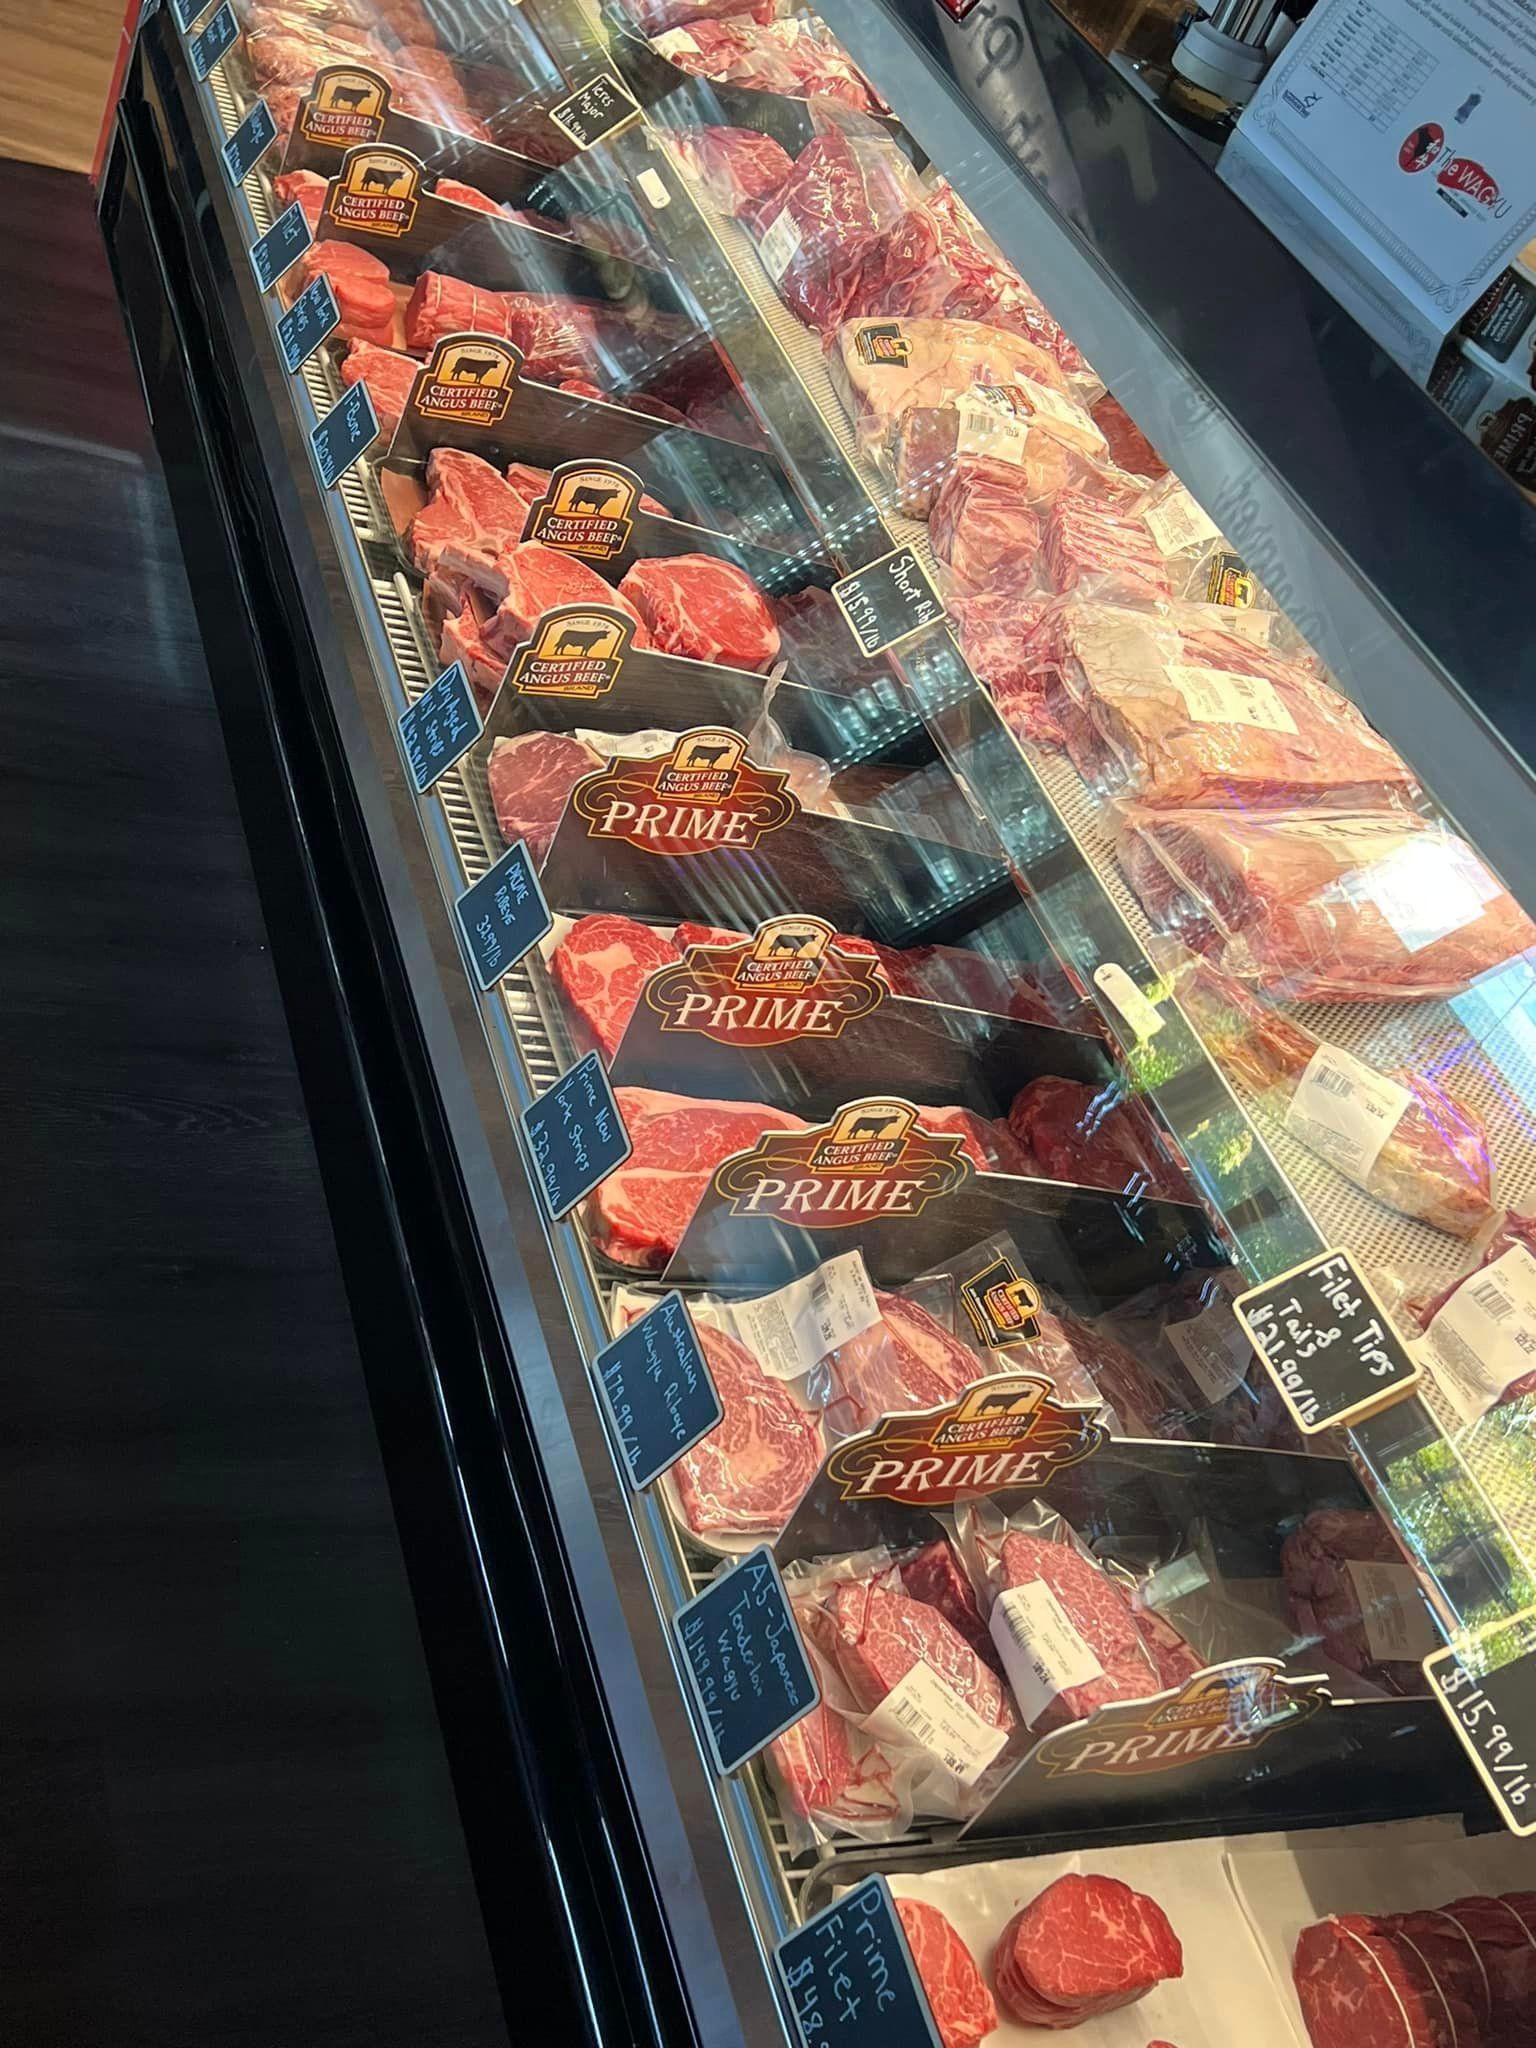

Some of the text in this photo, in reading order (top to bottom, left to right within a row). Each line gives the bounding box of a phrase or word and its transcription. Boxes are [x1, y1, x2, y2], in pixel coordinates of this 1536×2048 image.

[577, 92, 604, 118] Major
[592, 78, 614, 107] Teres
[305, 121, 348, 135] ANGUS
[313, 112, 372, 126] CERTIFIED
[1437, 146, 1459, 176] The
[1457, 164, 1513, 219] WAGYU
[334, 206, 377, 219] ANGUS
[342, 194, 405, 209] CERTIFIED
[420, 395, 499, 411] ANGUS BEEF
[430, 385, 498, 399] CERTIFIED
[537, 527, 619, 543] ANGUS BEEF
[547, 517, 618, 531] CERTIFIED
[889, 556, 936, 624] Short Rib
[520, 672, 607, 684] ANGUS BEEF
[530, 660, 606, 674] CERTIFIED
[437, 666, 468, 743] Dry Aged
[658, 781, 729, 792] ANGUS BEEF
[666, 772, 728, 782] CERTIFIED
[600, 801, 758, 843] PRIME
[505, 861, 529, 904] PRIME
[737, 971, 813, 982] ANGUS BEEF
[747, 960, 813, 972] CERTIFIED
[674, 993, 843, 1031] PRIME
[577, 1056, 597, 1107] Prime
[554, 1077, 590, 1172] York Strips
[813, 1152, 894, 1166] ANGUS BEEF
[824, 1141, 896, 1155] CERTIFIED
[744, 1179, 926, 1214] PRIME
[1308, 1256, 1394, 1376] Filet Tips
[660, 1302, 697, 1394] Australian
[642, 1317, 686, 1440] Wagyu Ribeye
[1247, 1304, 1320, 1424] $21.99/lb
[935, 1426, 1024, 1444] ANGUS BEEF
[948, 1415, 1026, 1433] CERTIFIED
[857, 1451, 1056, 1493] PRIME
[728, 1590, 763, 1697] Tenderloin
[718, 1629, 741, 1701] Wagyu
[1064, 1724, 1251, 1772] PRIME
[848, 1886, 895, 2012] Prime
[816, 1915, 860, 2022] Filet
